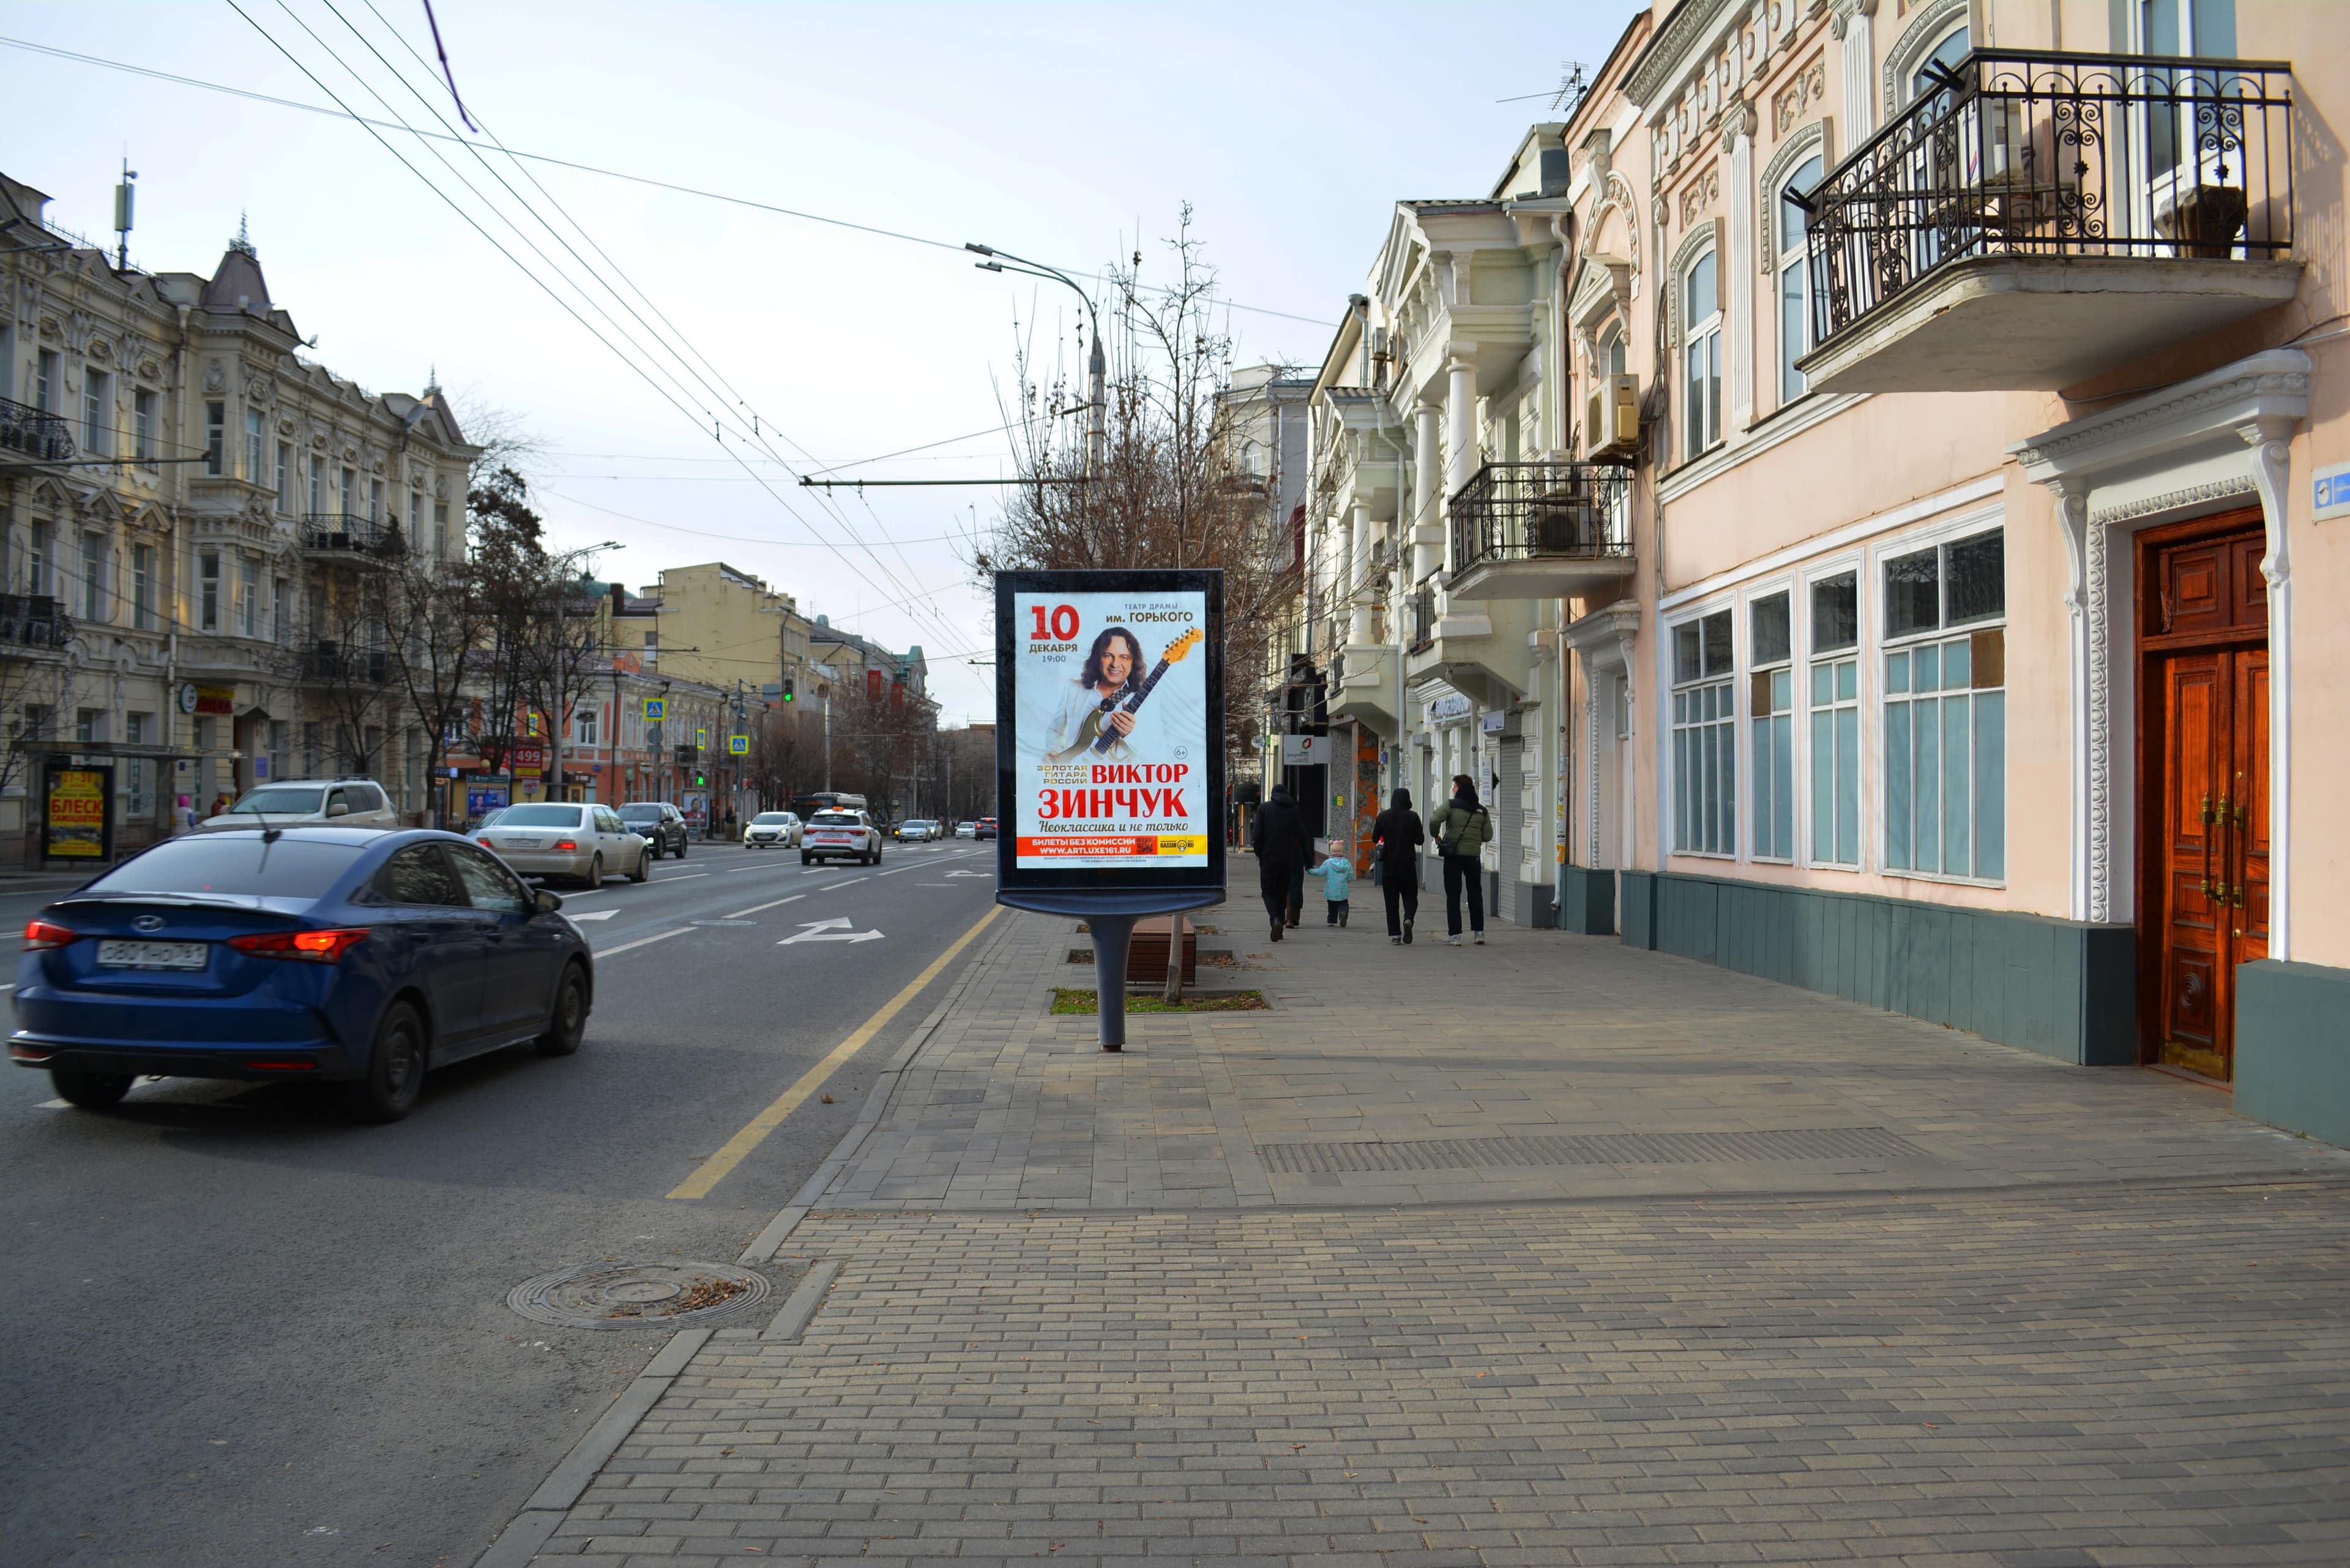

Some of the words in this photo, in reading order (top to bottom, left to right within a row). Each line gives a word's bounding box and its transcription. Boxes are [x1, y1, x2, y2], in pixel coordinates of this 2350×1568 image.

[1031, 604, 1080, 641] 10
[1130, 611, 1193, 622] ГОРЬКОГО
[1029, 643, 1078, 654] ДЕКАБРЯ
[1092, 764, 1188, 783] ВИКТОР
[51, 799, 103, 813] БЛЕСК
[1038, 788, 1188, 819] ЗИНЧУК
[1039, 821, 1114, 832] Неоклассика
[1119, 823, 1127, 832] и
[1146, 822, 1188, 831] только
